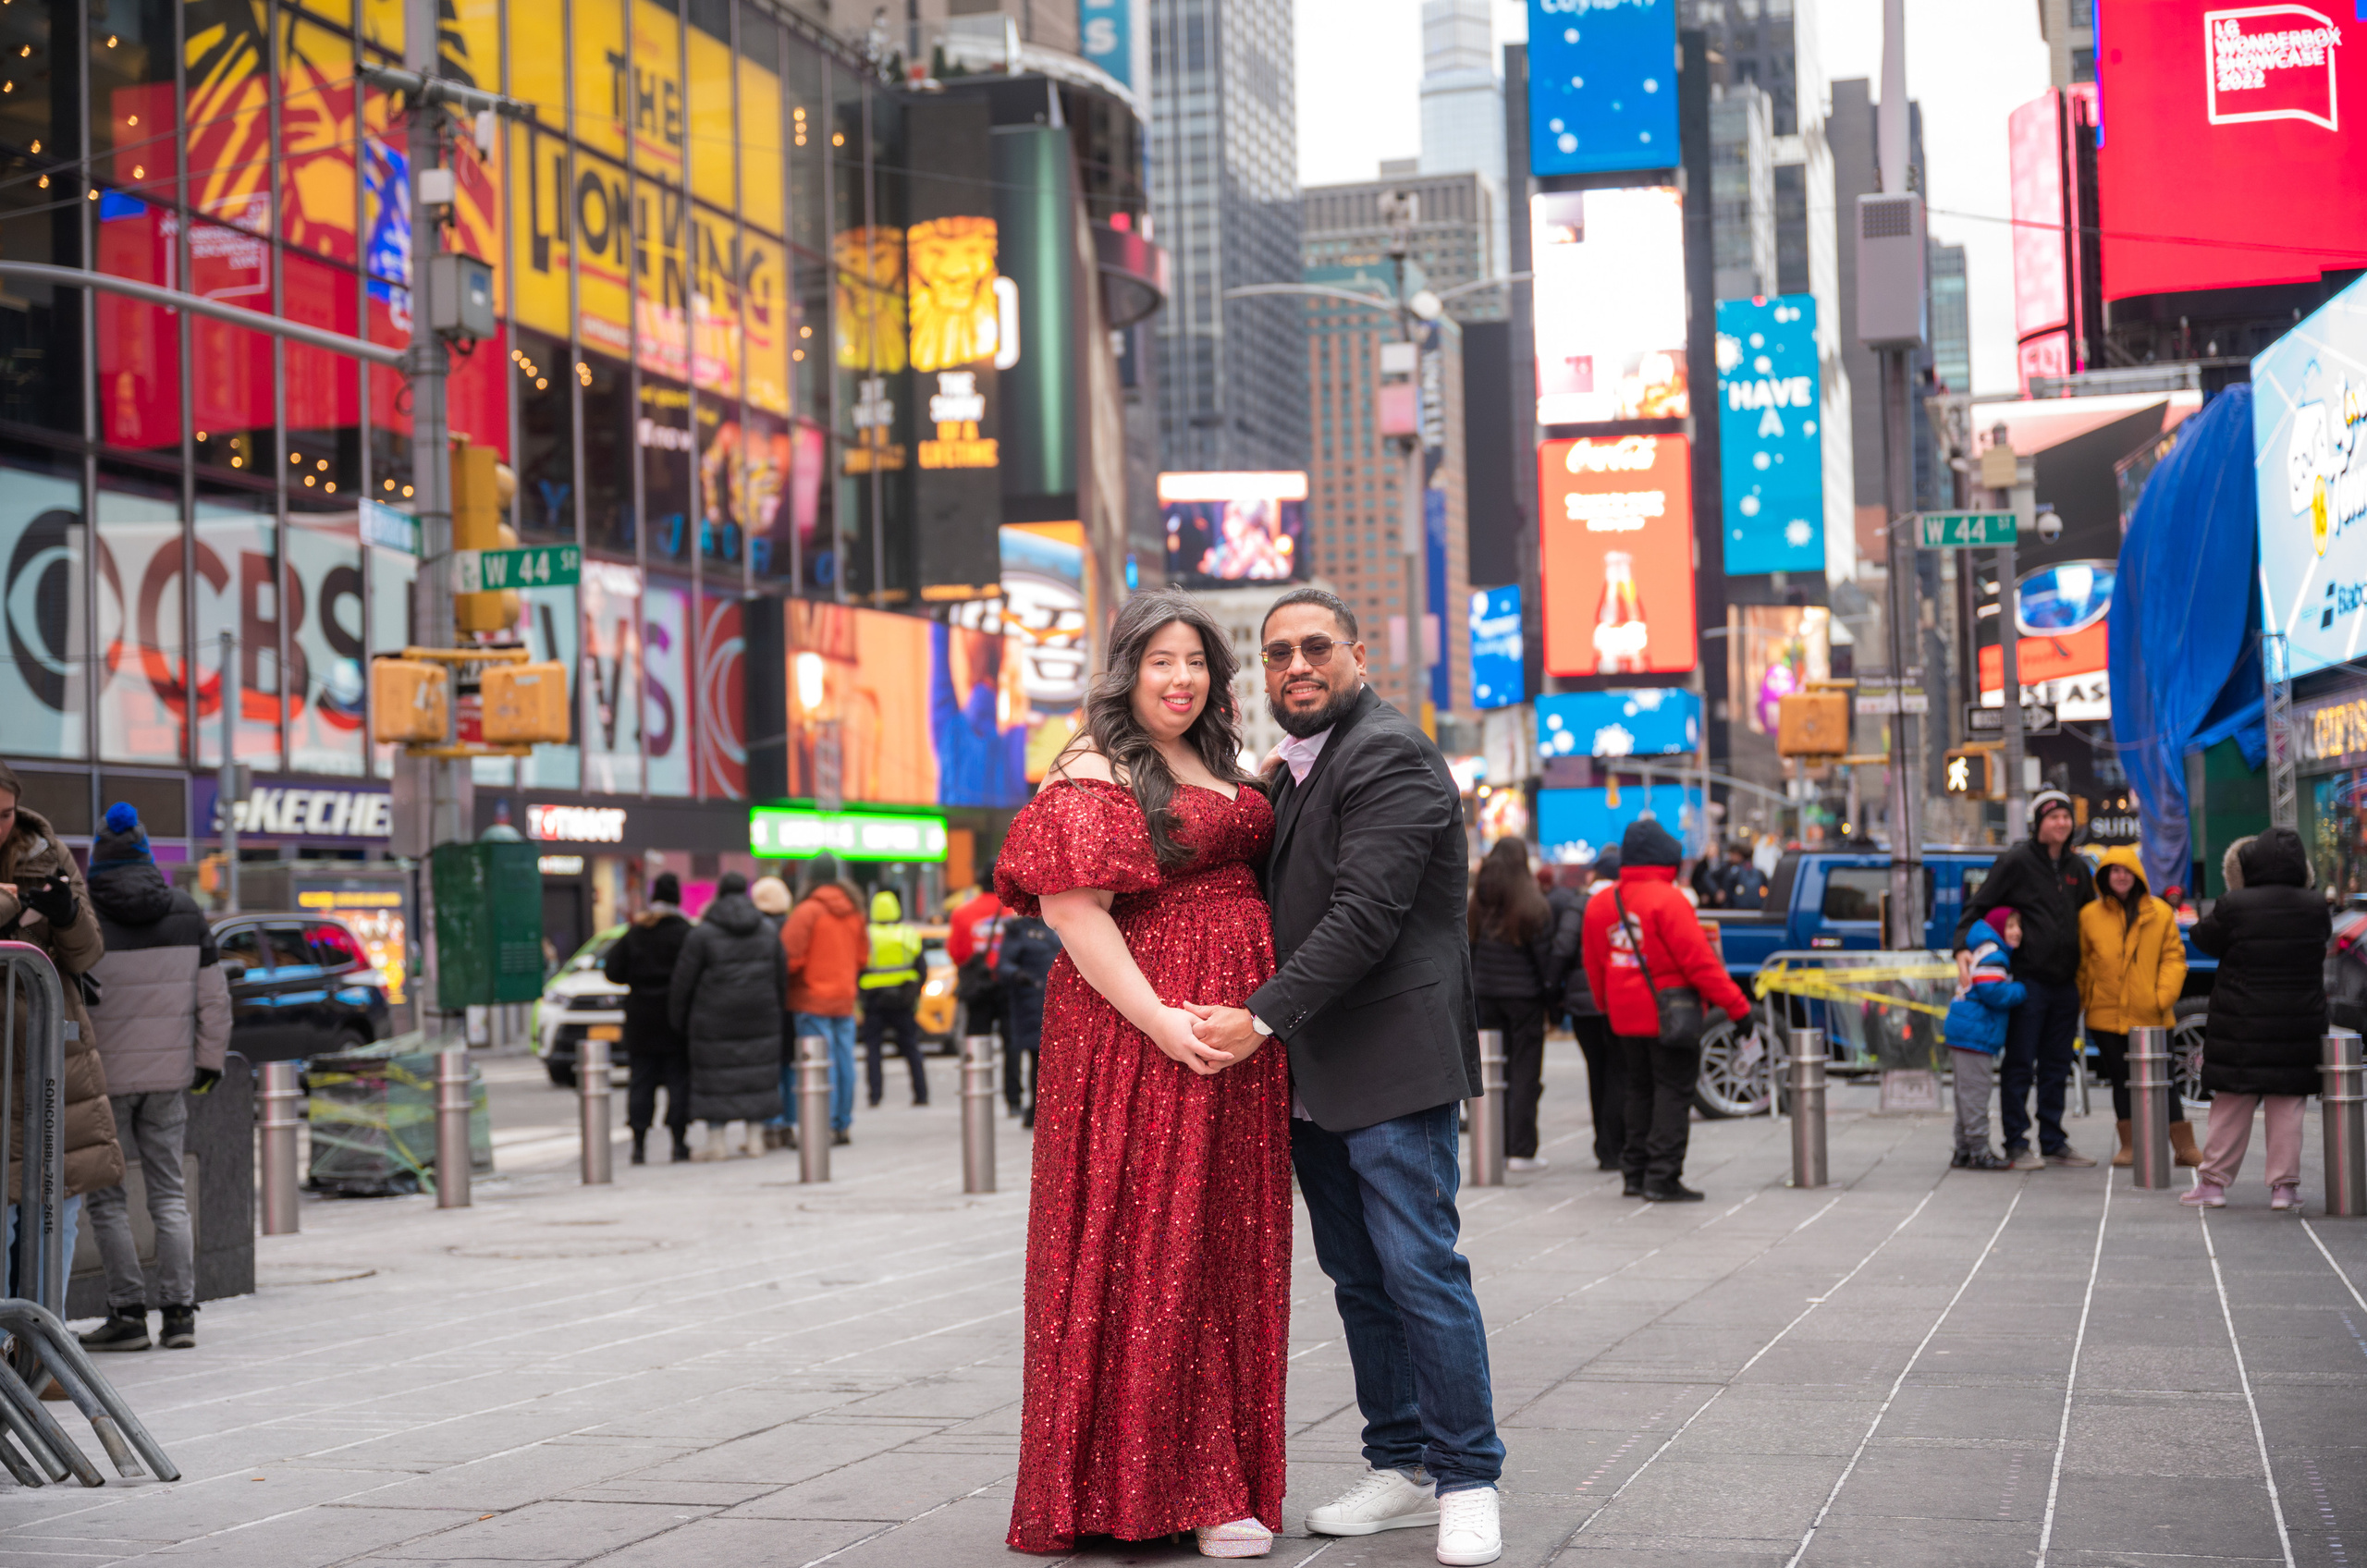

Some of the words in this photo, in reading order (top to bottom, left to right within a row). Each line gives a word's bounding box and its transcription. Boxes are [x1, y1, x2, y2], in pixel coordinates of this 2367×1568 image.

[2214, 18, 2240, 38] LG
[2215, 26, 2343, 55] WONDERBOX
[2215, 46, 2325, 74] SHOWCASE
[605, 46, 682, 148] THE
[2216, 69, 2266, 92] 2022
[526, 116, 652, 277] LION
[658, 169, 771, 325] KING
[1727, 375, 1813, 411] HAVE
[1758, 406, 1785, 439] A
[1926, 516, 1945, 544] W
[1954, 516, 1987, 544] 44
[484, 555, 508, 587] W
[518, 550, 550, 584] 44
[137, 533, 366, 730] CBS
